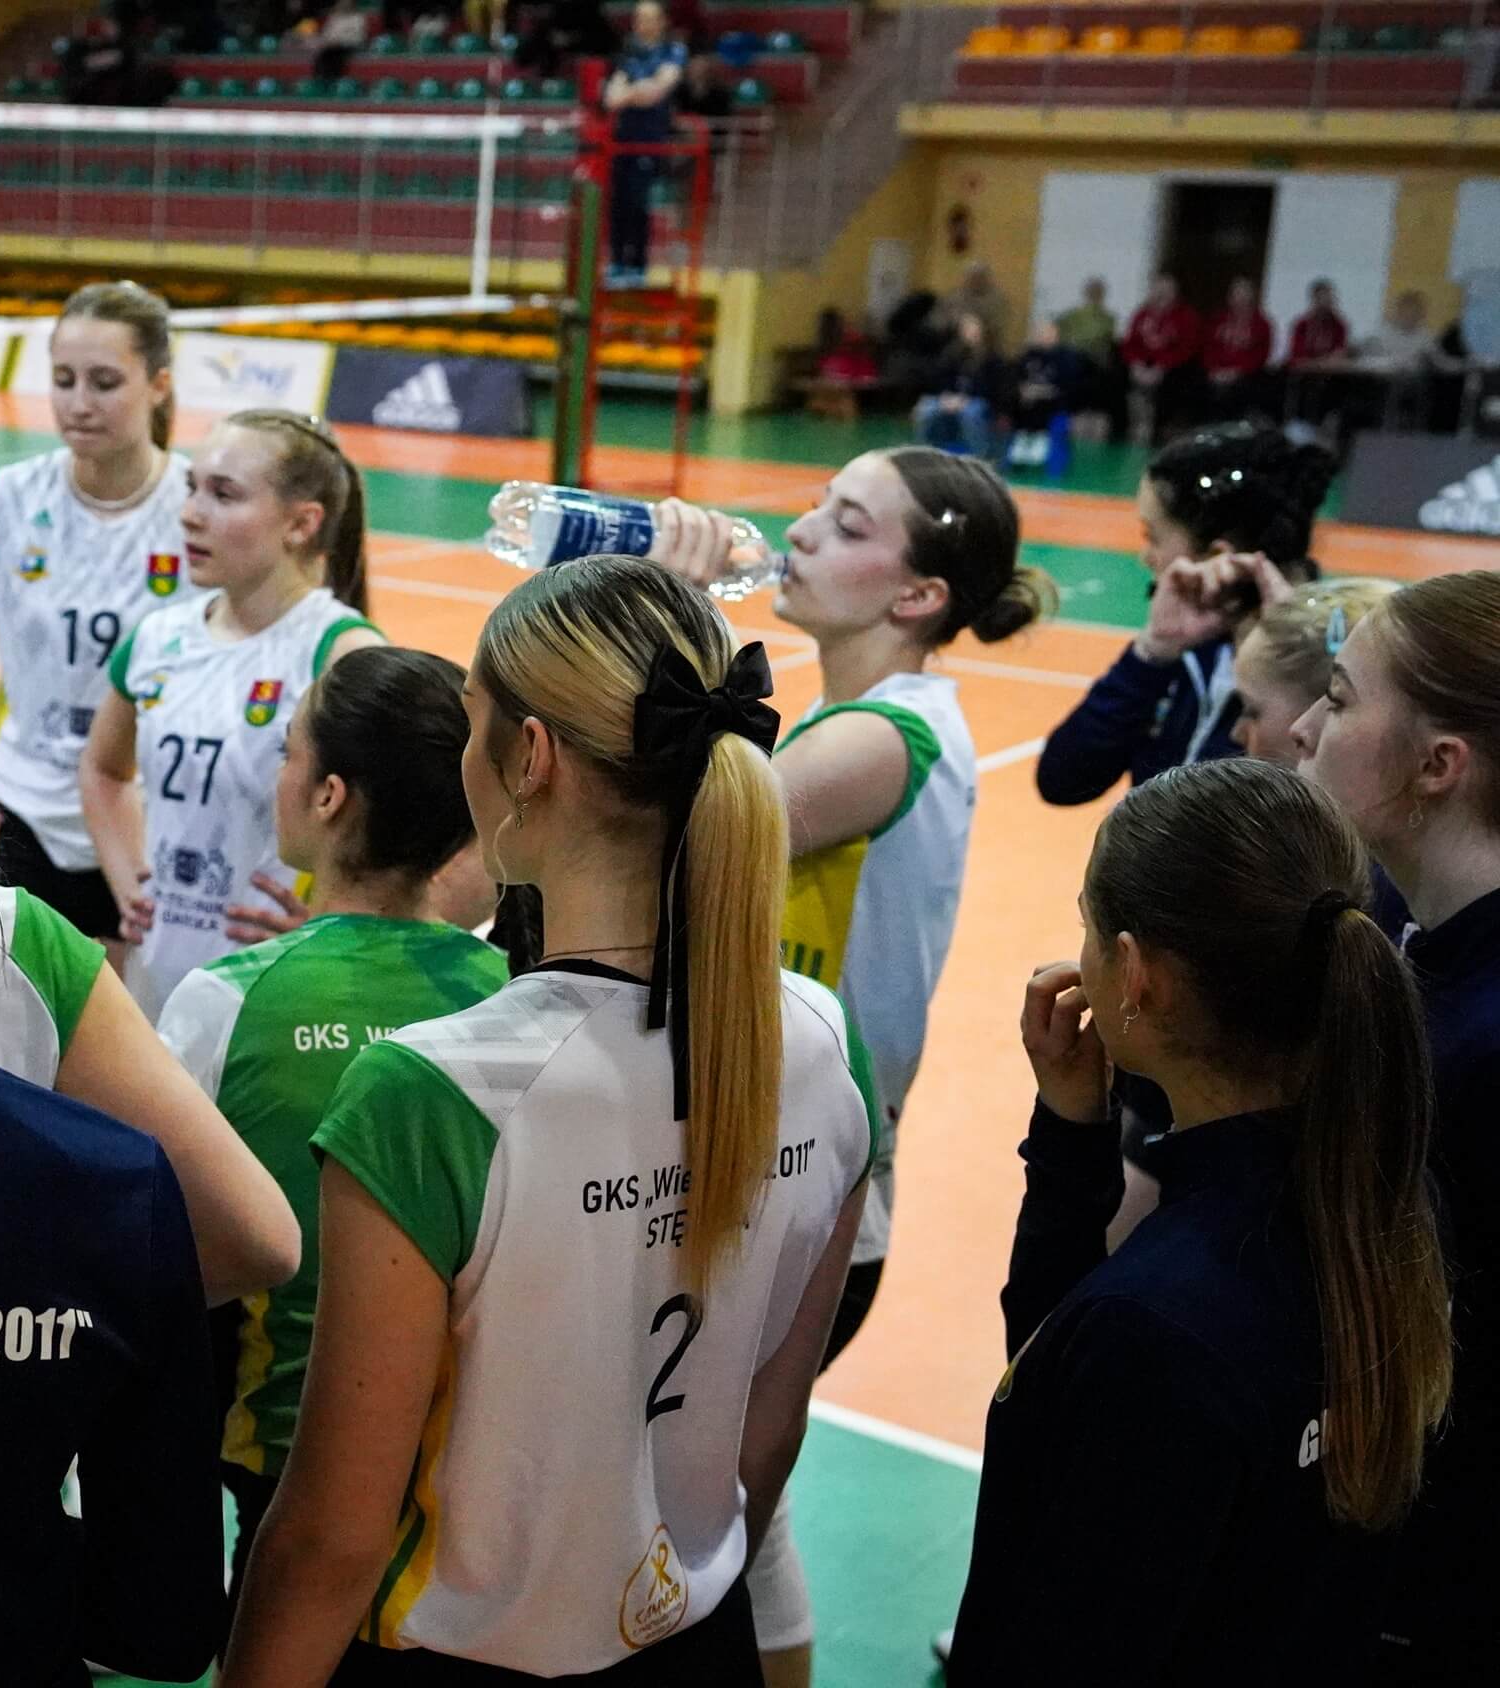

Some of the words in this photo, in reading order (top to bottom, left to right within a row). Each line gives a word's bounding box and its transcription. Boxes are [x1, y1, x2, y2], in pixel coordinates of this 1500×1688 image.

[62, 608, 121, 668] 19
[158, 734, 224, 805] 27
[294, 1023, 350, 1052] GKS
[582, 1174, 639, 1213] GKS
[646, 1208, 688, 1248] STĘ
[646, 1293, 704, 1427] 2
